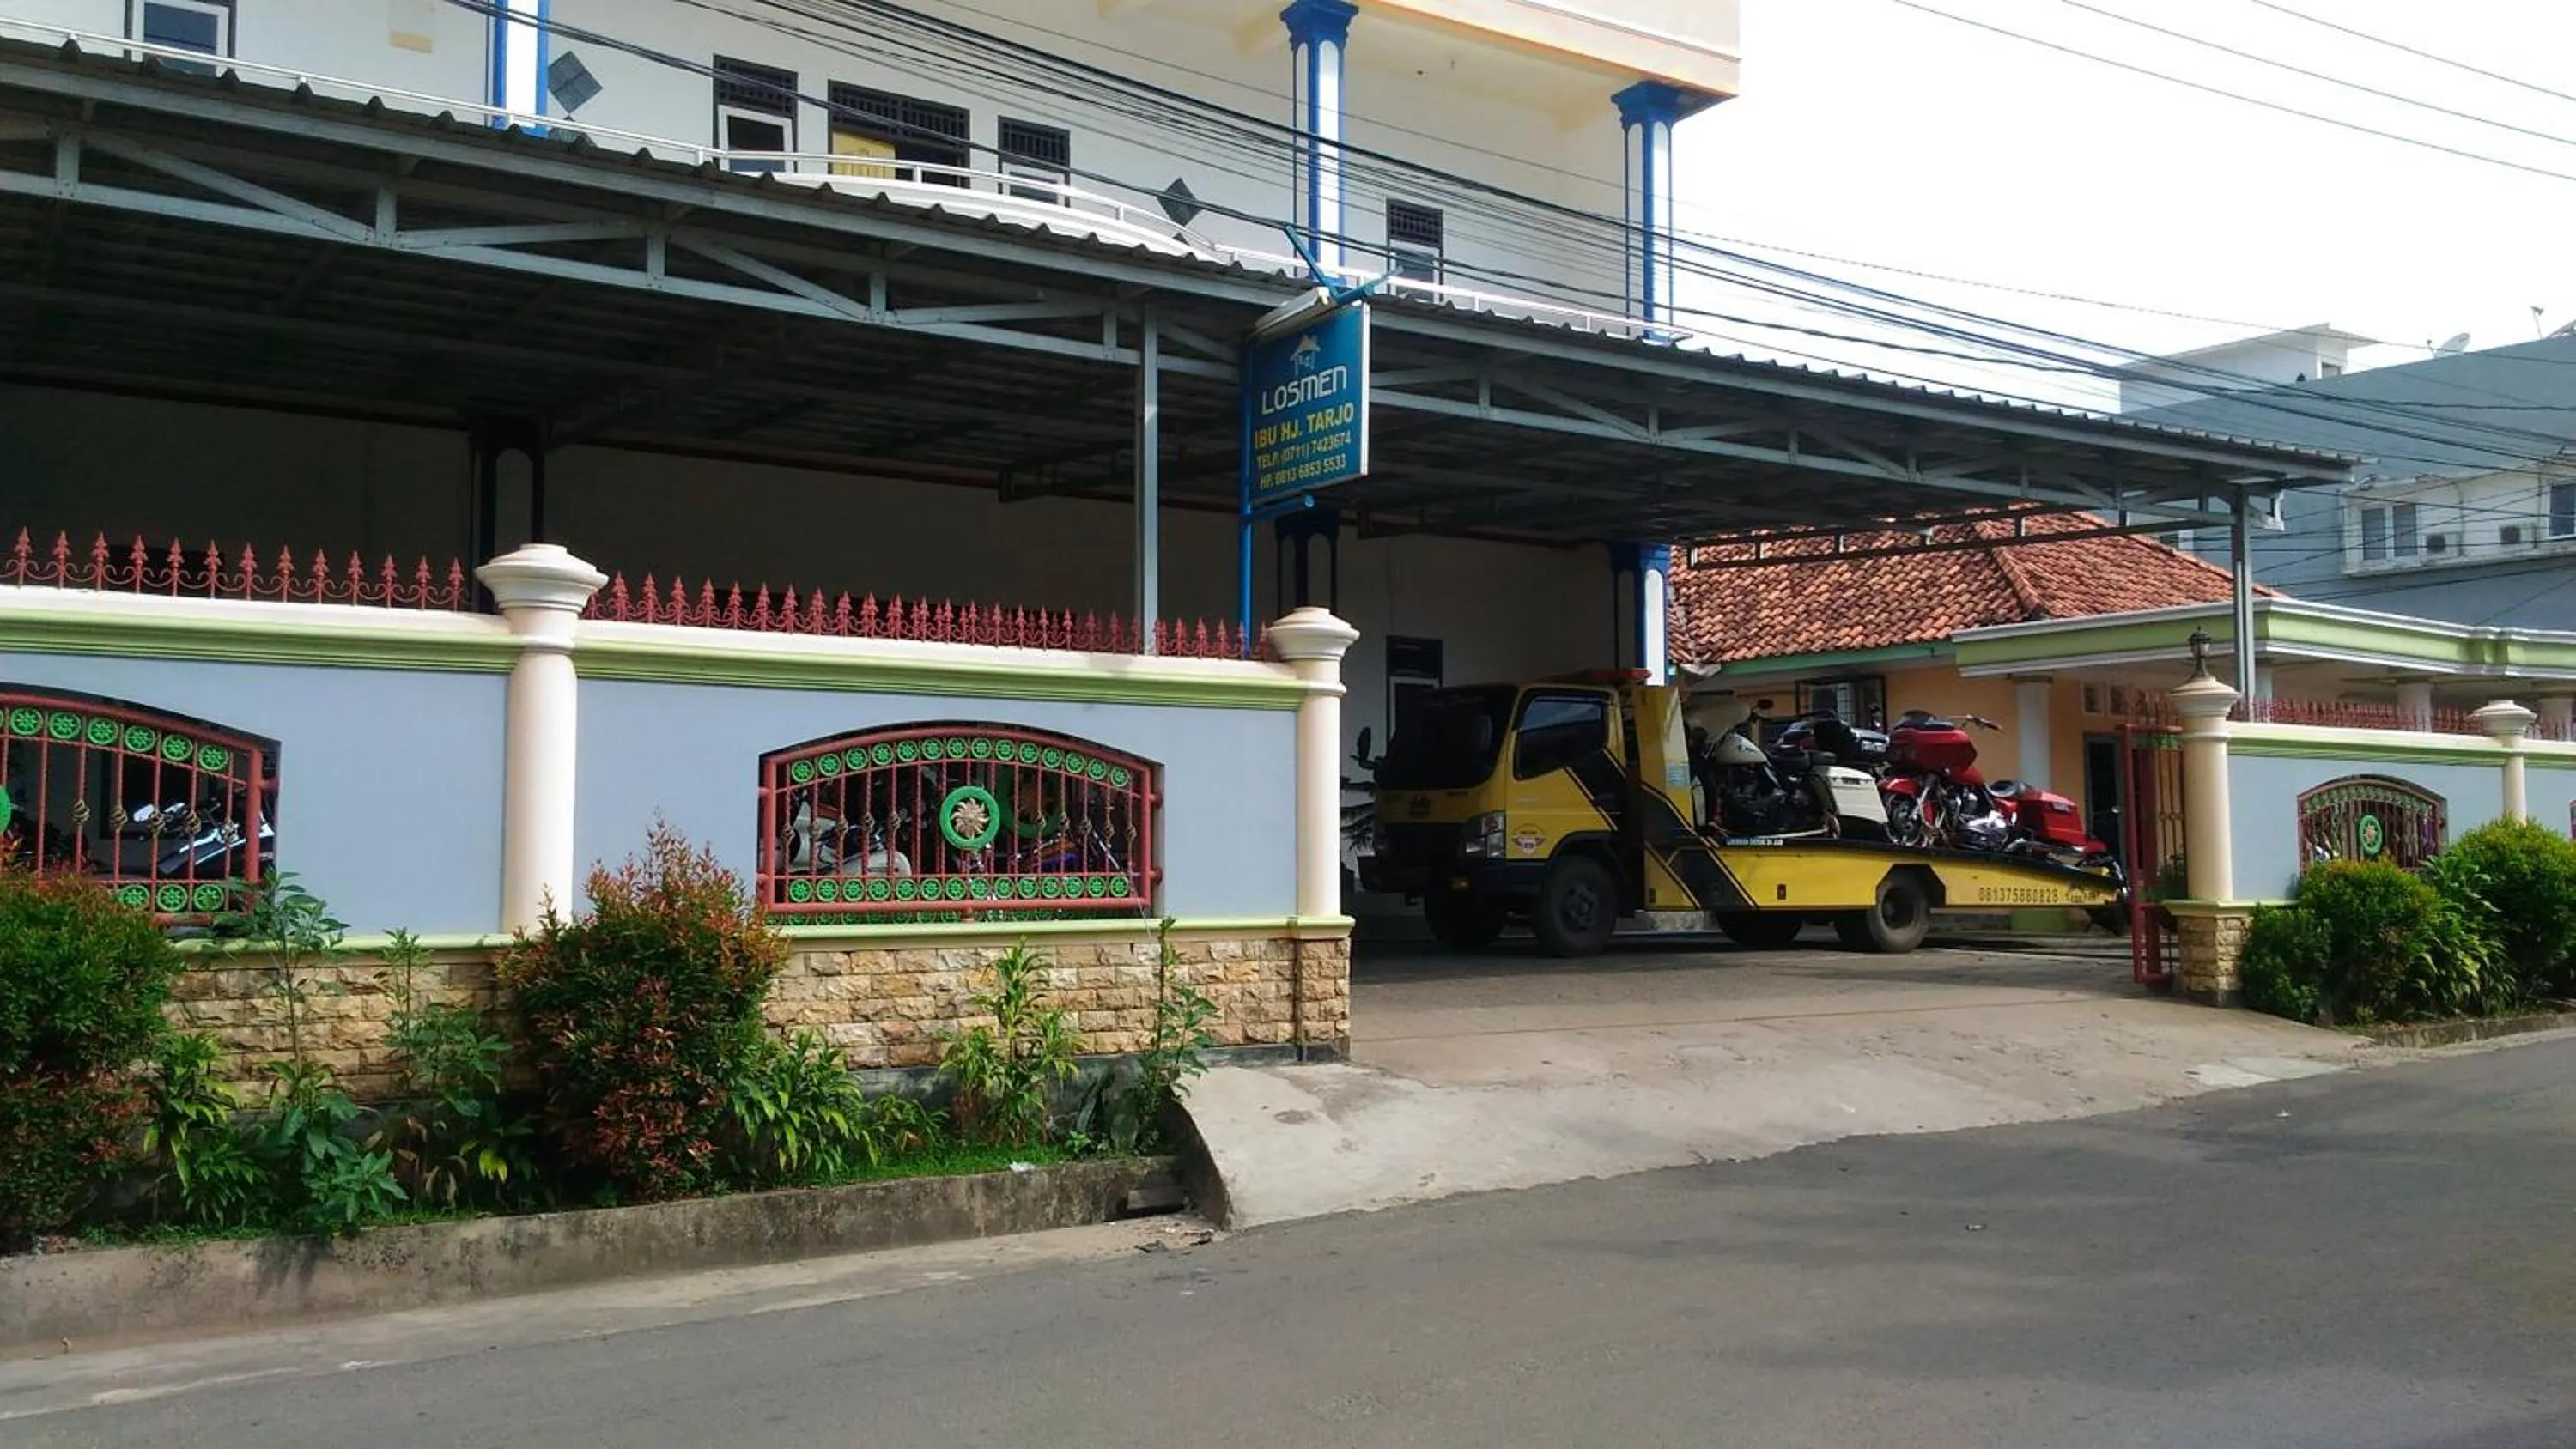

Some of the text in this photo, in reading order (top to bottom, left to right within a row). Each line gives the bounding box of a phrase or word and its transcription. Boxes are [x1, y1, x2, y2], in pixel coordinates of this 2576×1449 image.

[1261, 365, 1347, 415] LOSMEN
[1255, 403, 1354, 448] IBU HJ. TARJO
